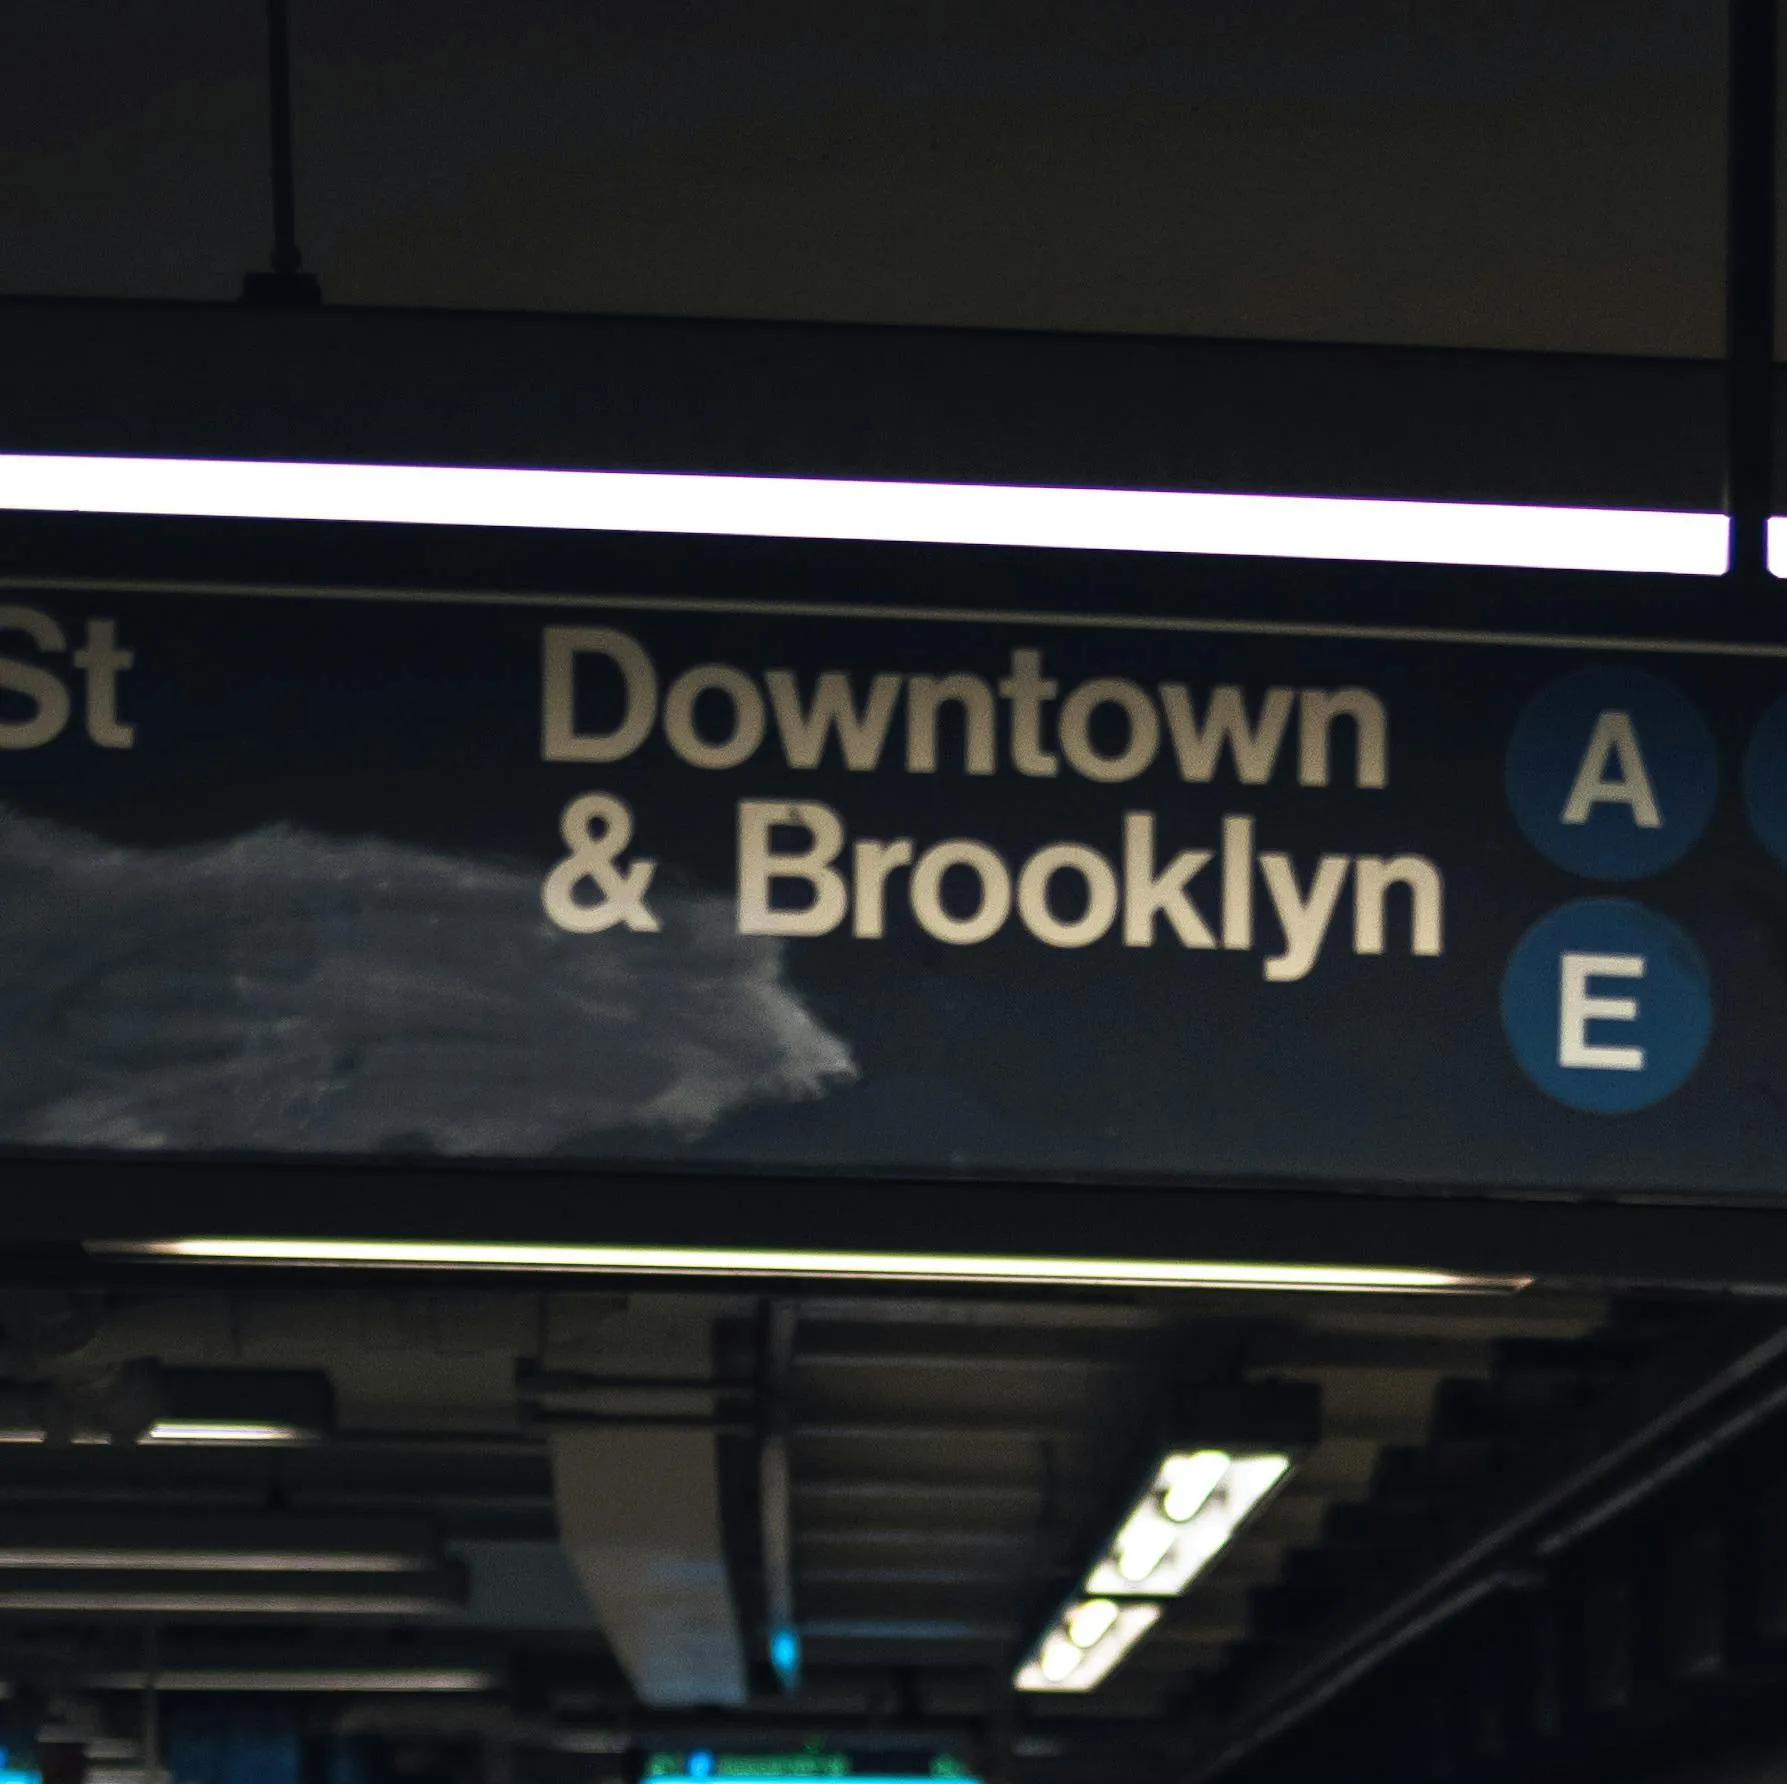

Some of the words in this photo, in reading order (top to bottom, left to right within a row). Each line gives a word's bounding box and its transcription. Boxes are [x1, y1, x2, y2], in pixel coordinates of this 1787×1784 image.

[542, 628, 1388, 790] Downtown
[1560, 711, 1663, 829] A
[541, 793, 661, 935] &
[735, 800, 1443, 983] Brooklyn
[1558, 951, 1645, 1071] E
